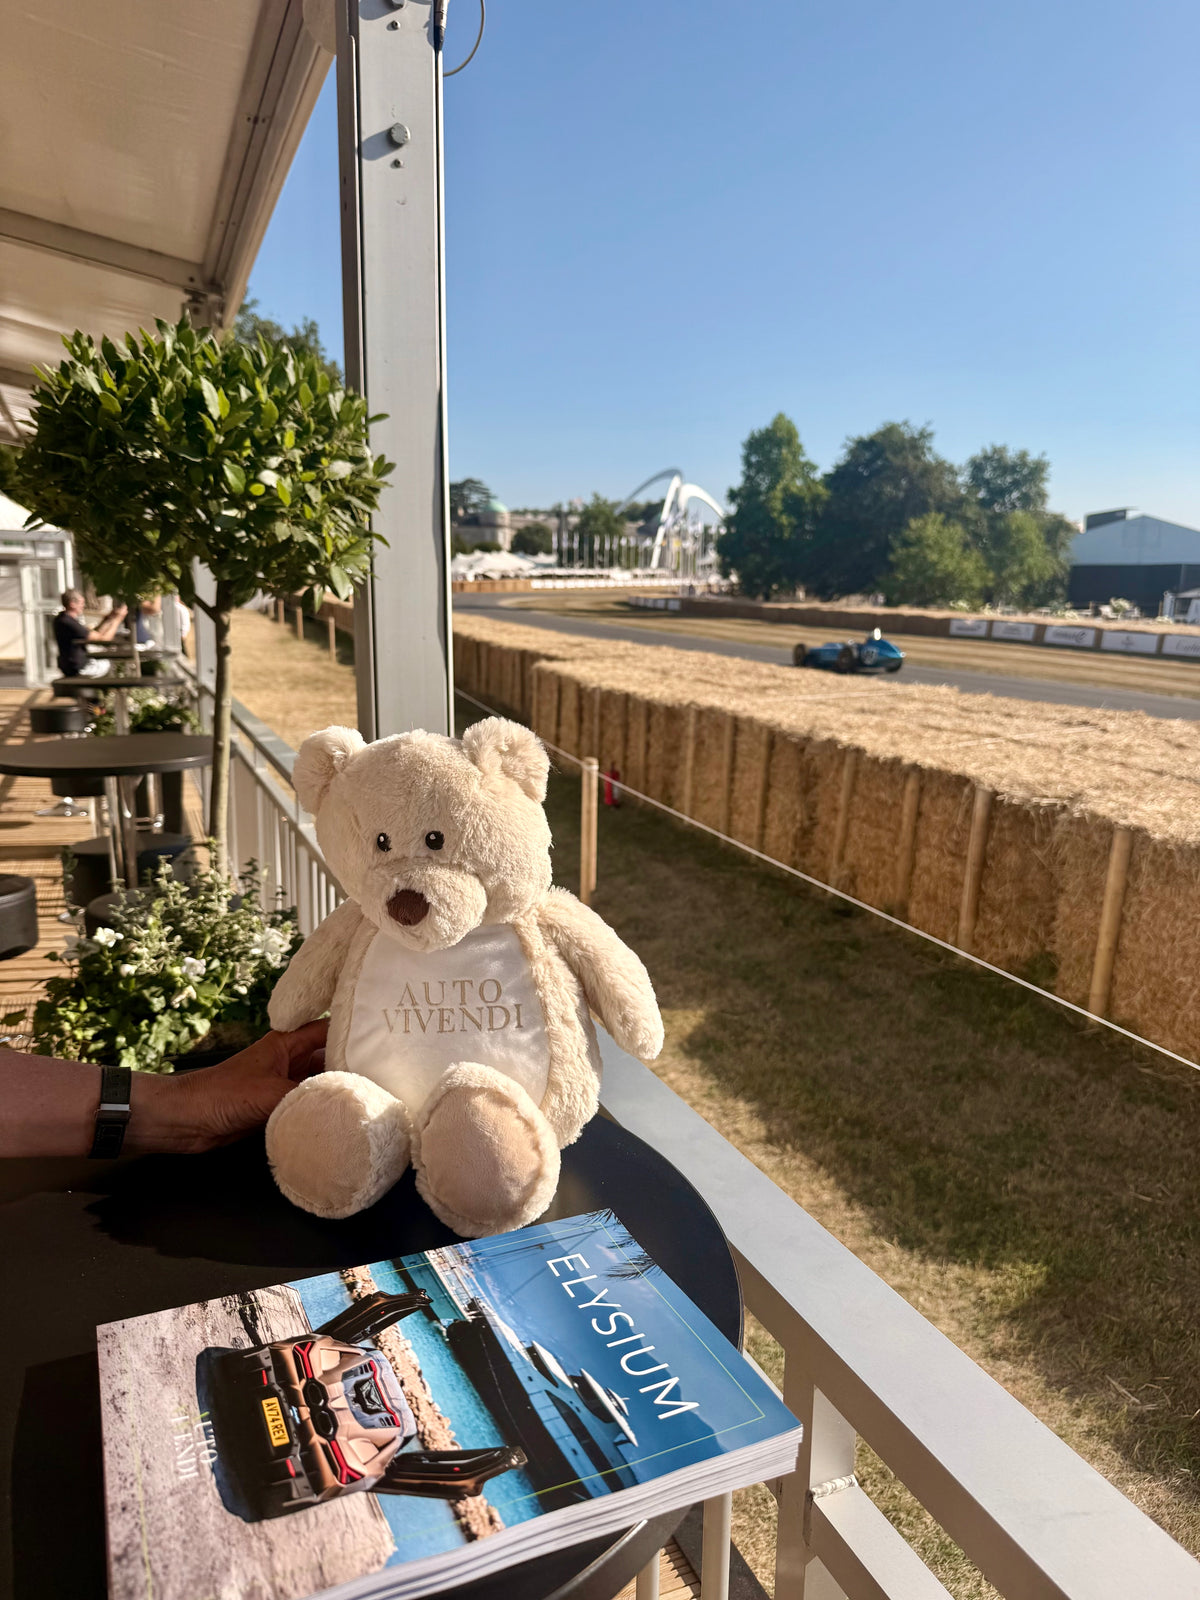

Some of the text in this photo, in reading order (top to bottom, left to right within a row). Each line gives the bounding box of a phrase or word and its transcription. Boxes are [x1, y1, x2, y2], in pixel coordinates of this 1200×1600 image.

[397, 978, 503, 1007] AUTO
[382, 1003, 524, 1034] VIVENDI
[546, 1252, 700, 1420] ELYSIUM
[265, 1402, 287, 1441] AV74 REV
